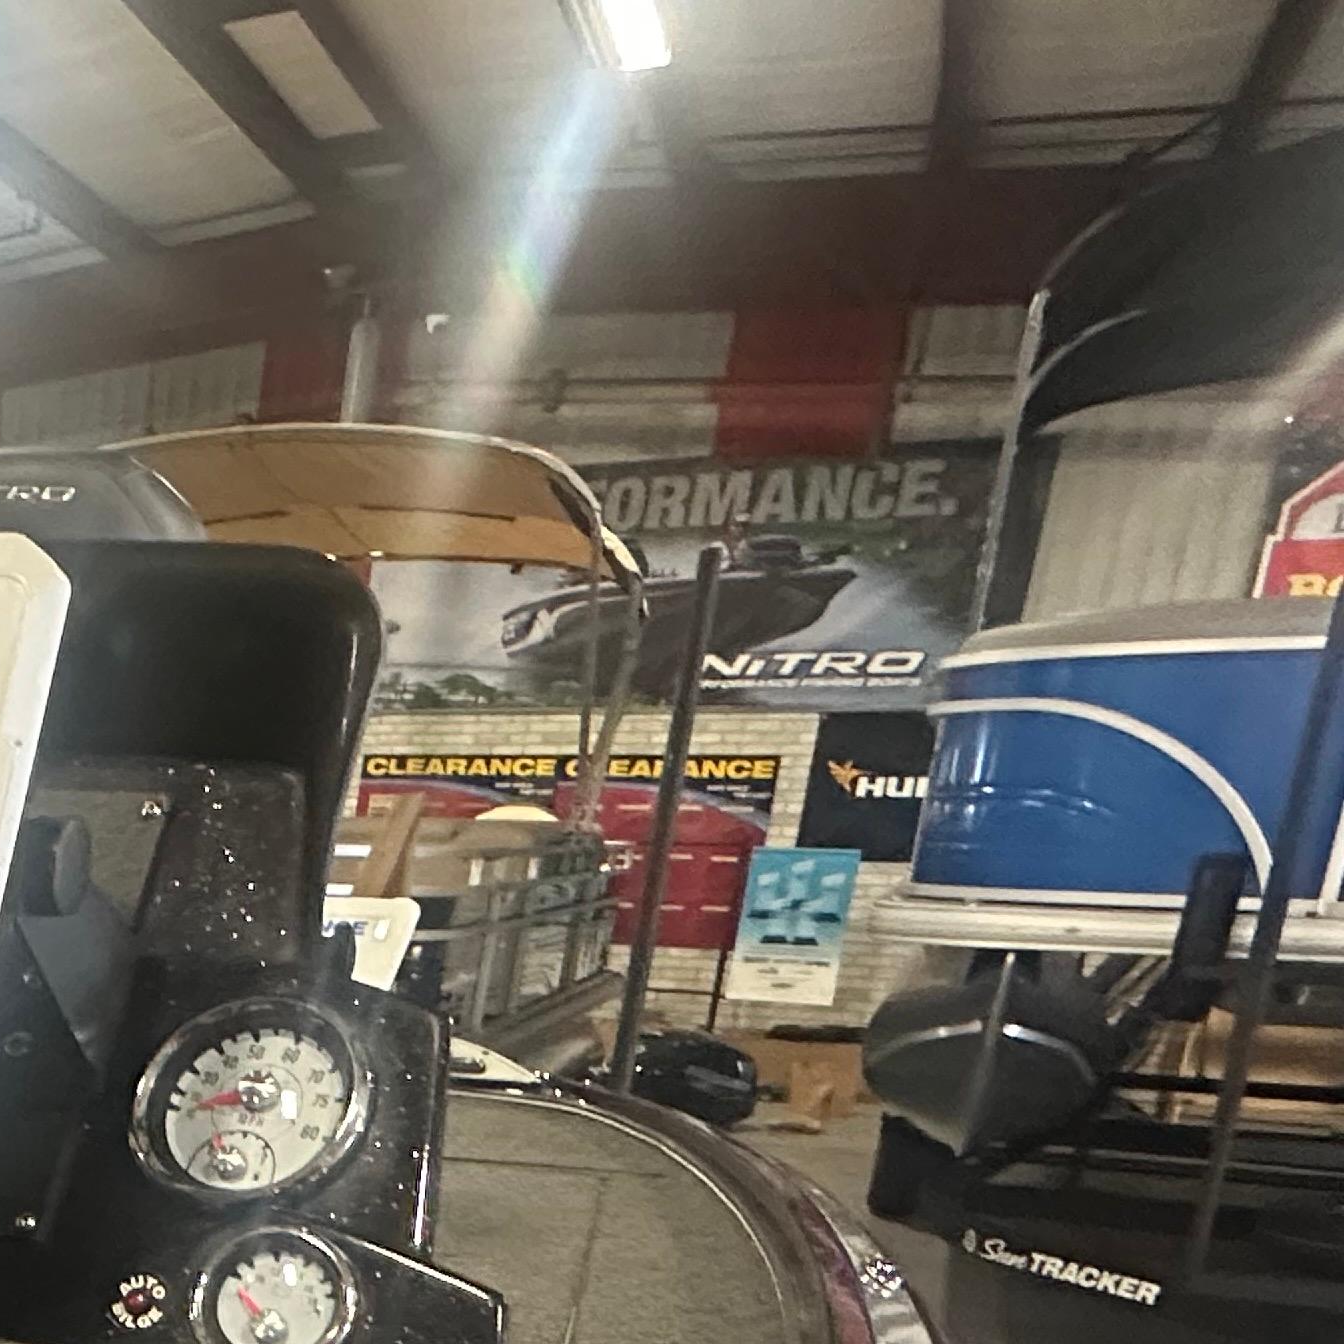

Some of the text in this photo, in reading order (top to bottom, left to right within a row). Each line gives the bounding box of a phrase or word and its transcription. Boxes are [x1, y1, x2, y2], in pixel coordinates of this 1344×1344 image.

[365, 756, 558, 777] CLEARANCE
[119, 1274, 166, 1300] AUTO
[1030, 1252, 1163, 1306] TRACKER
